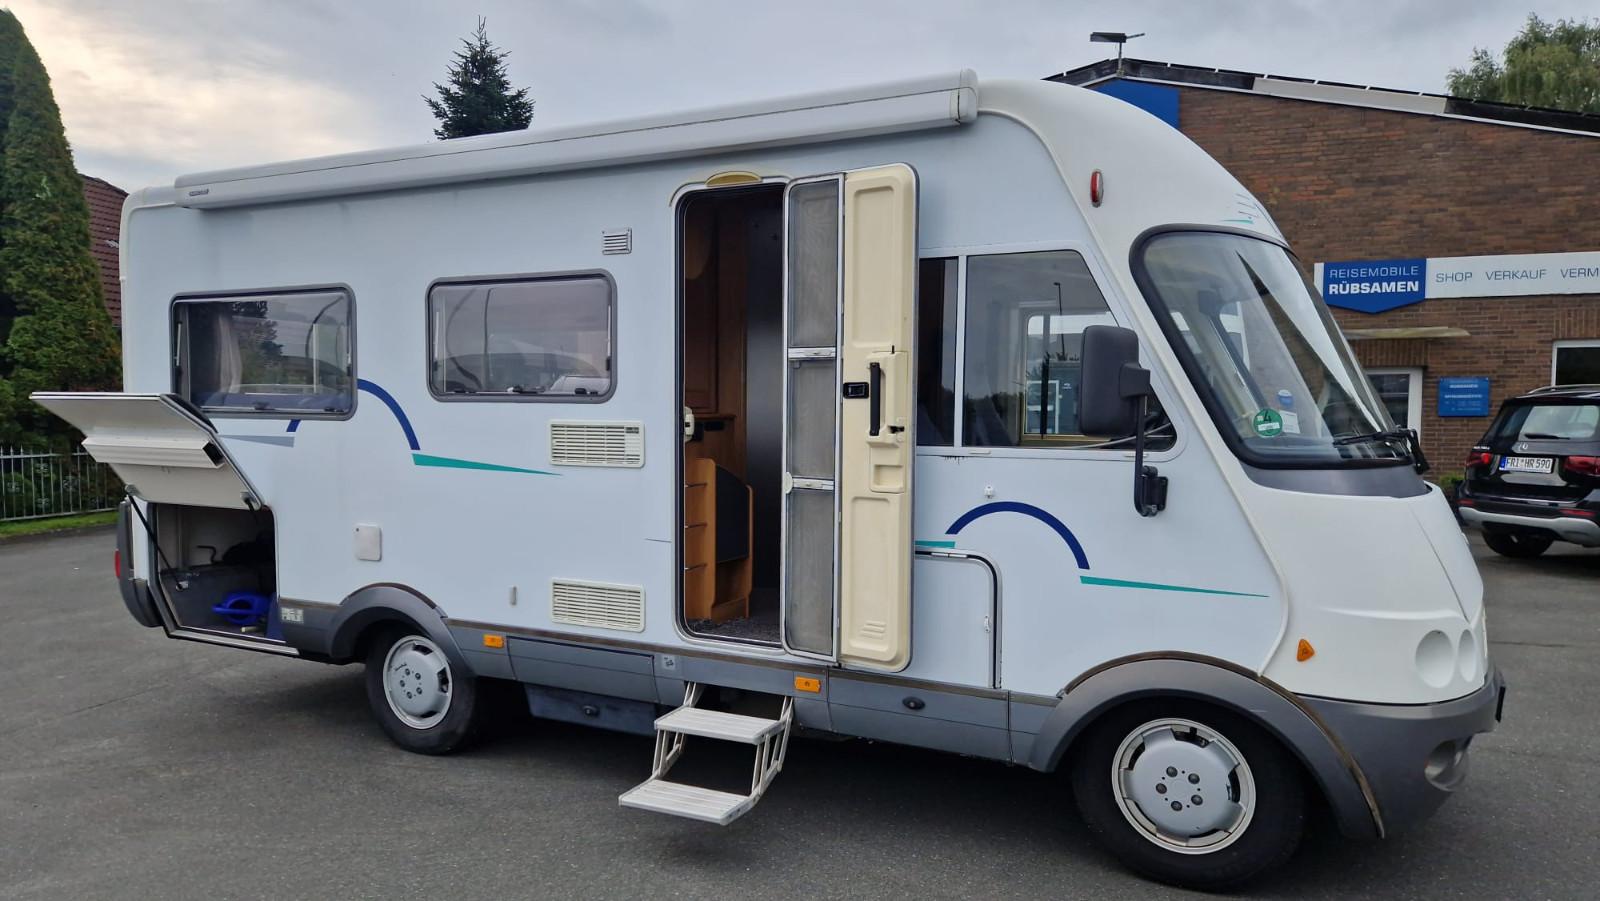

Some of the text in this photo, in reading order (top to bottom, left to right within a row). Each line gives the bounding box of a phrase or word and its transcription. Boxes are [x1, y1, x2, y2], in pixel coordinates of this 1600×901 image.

[1329, 265, 1419, 279] REISEMOBILE
[1435, 267, 1599, 283] SHOP VERKAUF VERM
[1328, 280, 1419, 295] RÜBSAMEN
[1535, 459, 1551, 469] 590
